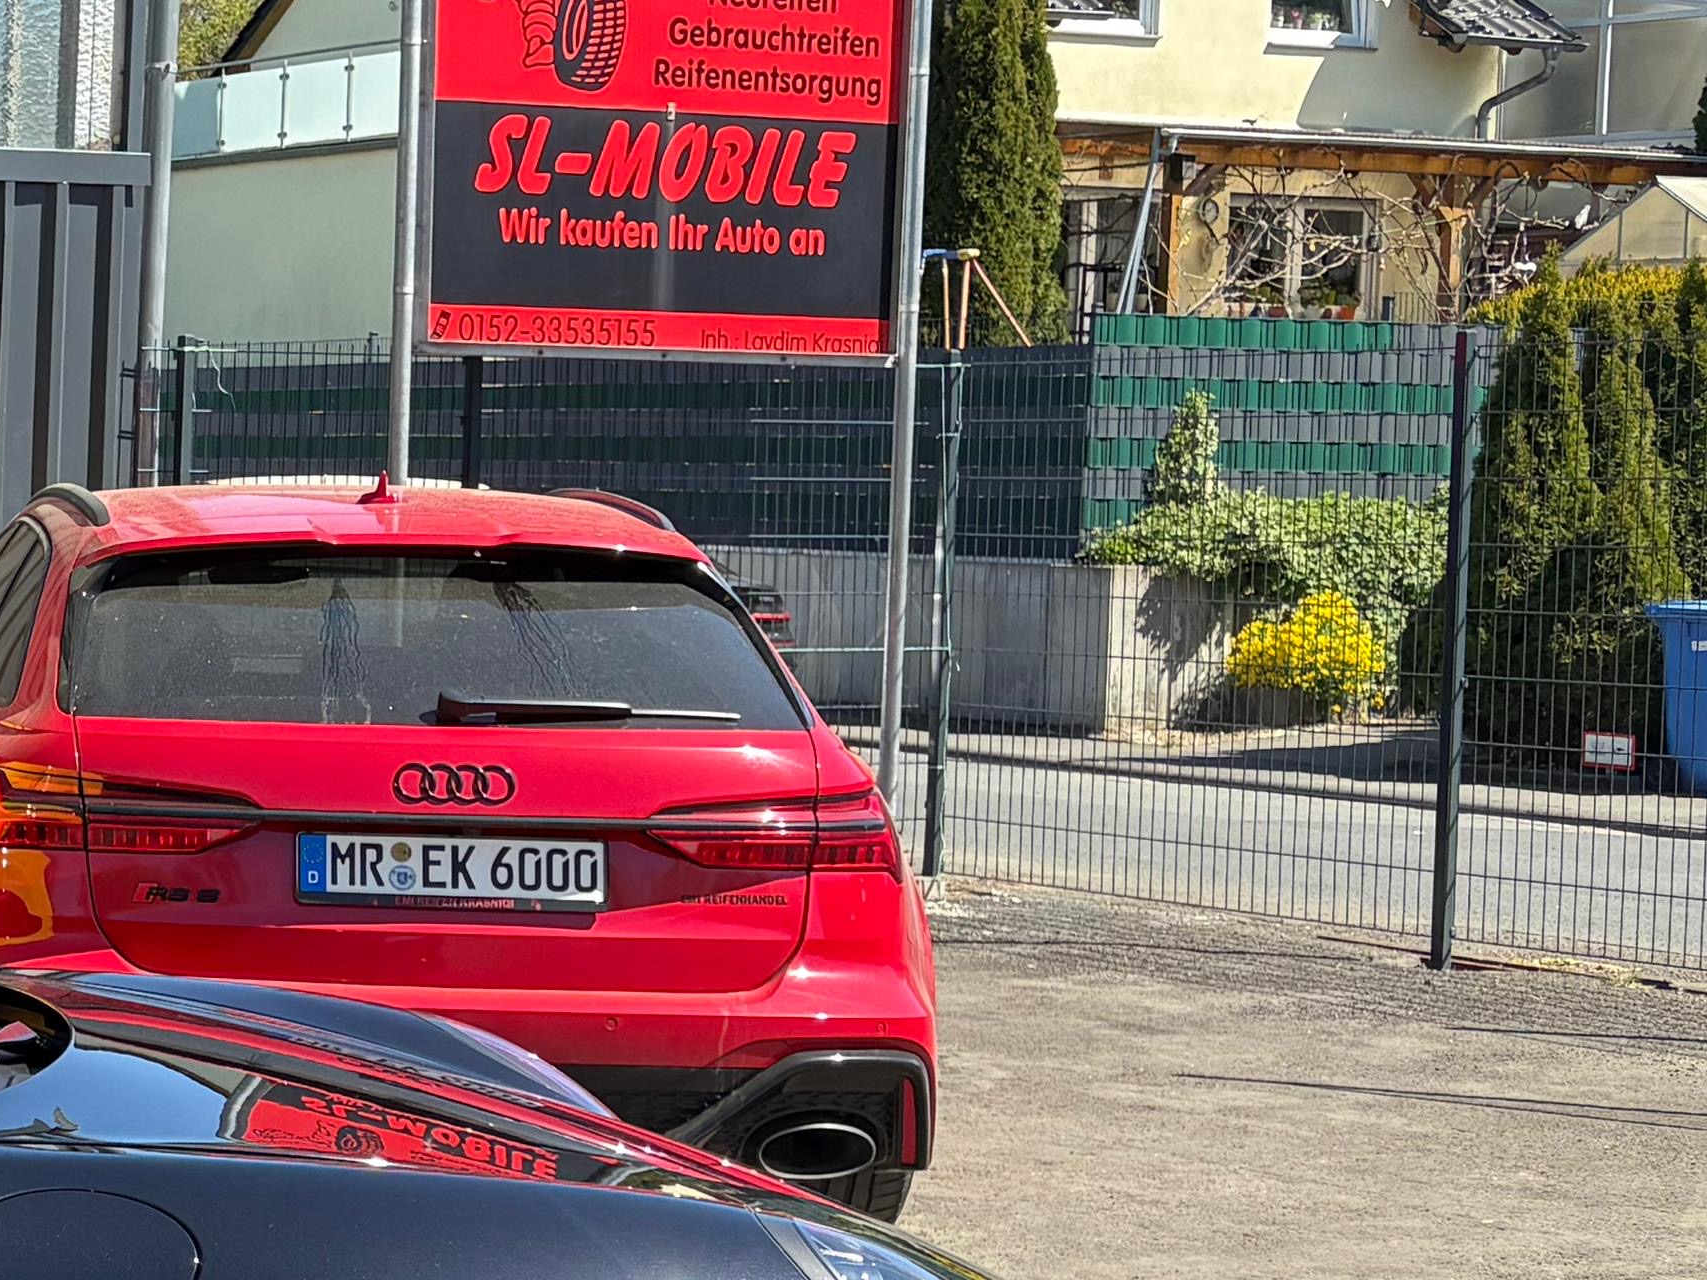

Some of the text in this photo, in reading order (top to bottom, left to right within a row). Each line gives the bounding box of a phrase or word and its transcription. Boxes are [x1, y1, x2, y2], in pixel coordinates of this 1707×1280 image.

[669, 17, 880, 58] Gebrauchtreifen
[654, 58, 882, 106] Reifenentsorgung
[474, 114, 857, 208] SL-MOBILE
[498, 206, 825, 256] Wir kaufen Ihr Auto an
[458, 312, 656, 347] 0152-33535155
[307, 871, 319, 884] D
[330, 841, 598, 893] MR EK 6000
